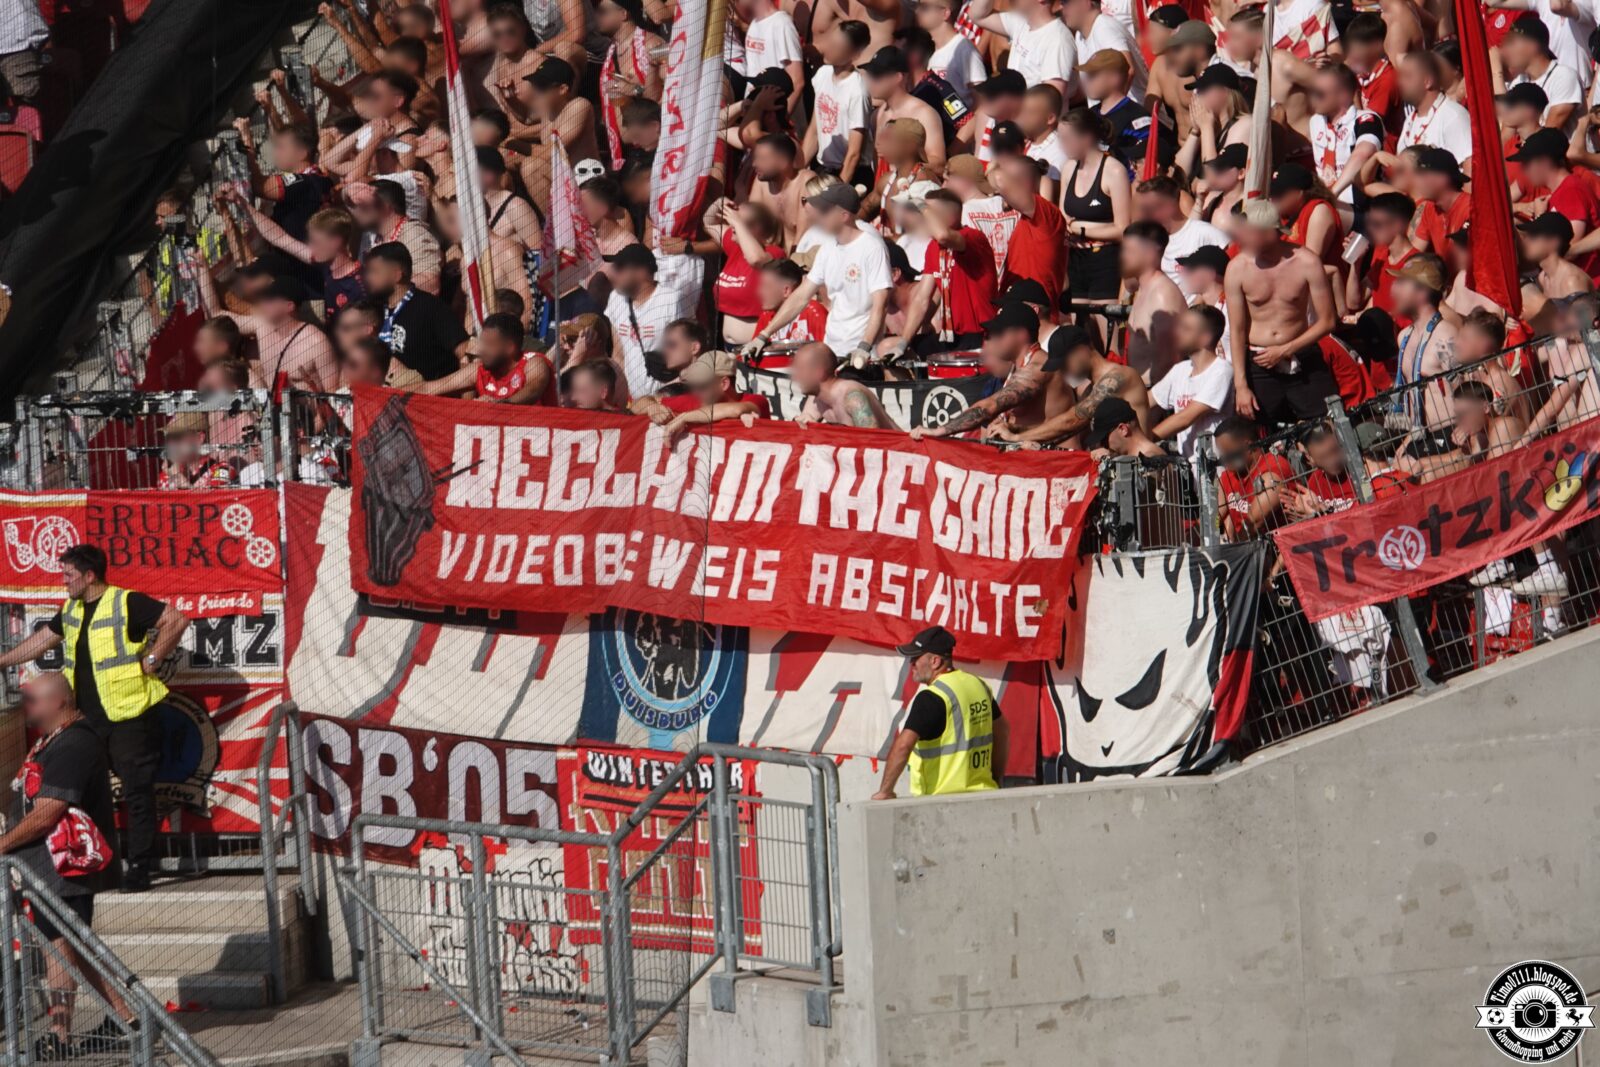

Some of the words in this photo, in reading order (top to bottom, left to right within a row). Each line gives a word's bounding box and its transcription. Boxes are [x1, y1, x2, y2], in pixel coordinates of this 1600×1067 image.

[445, 421, 793, 523] RECLAIM
[794, 442, 931, 540] THE
[928, 460, 1090, 562] GAME
[198, 592, 254, 615] friends
[806, 552, 1042, 639] ABSCHALTE
[611, 670, 718, 730] DUISBURG
[969, 699, 988, 716] SDS
[584, 750, 744, 791] WINTERHR
